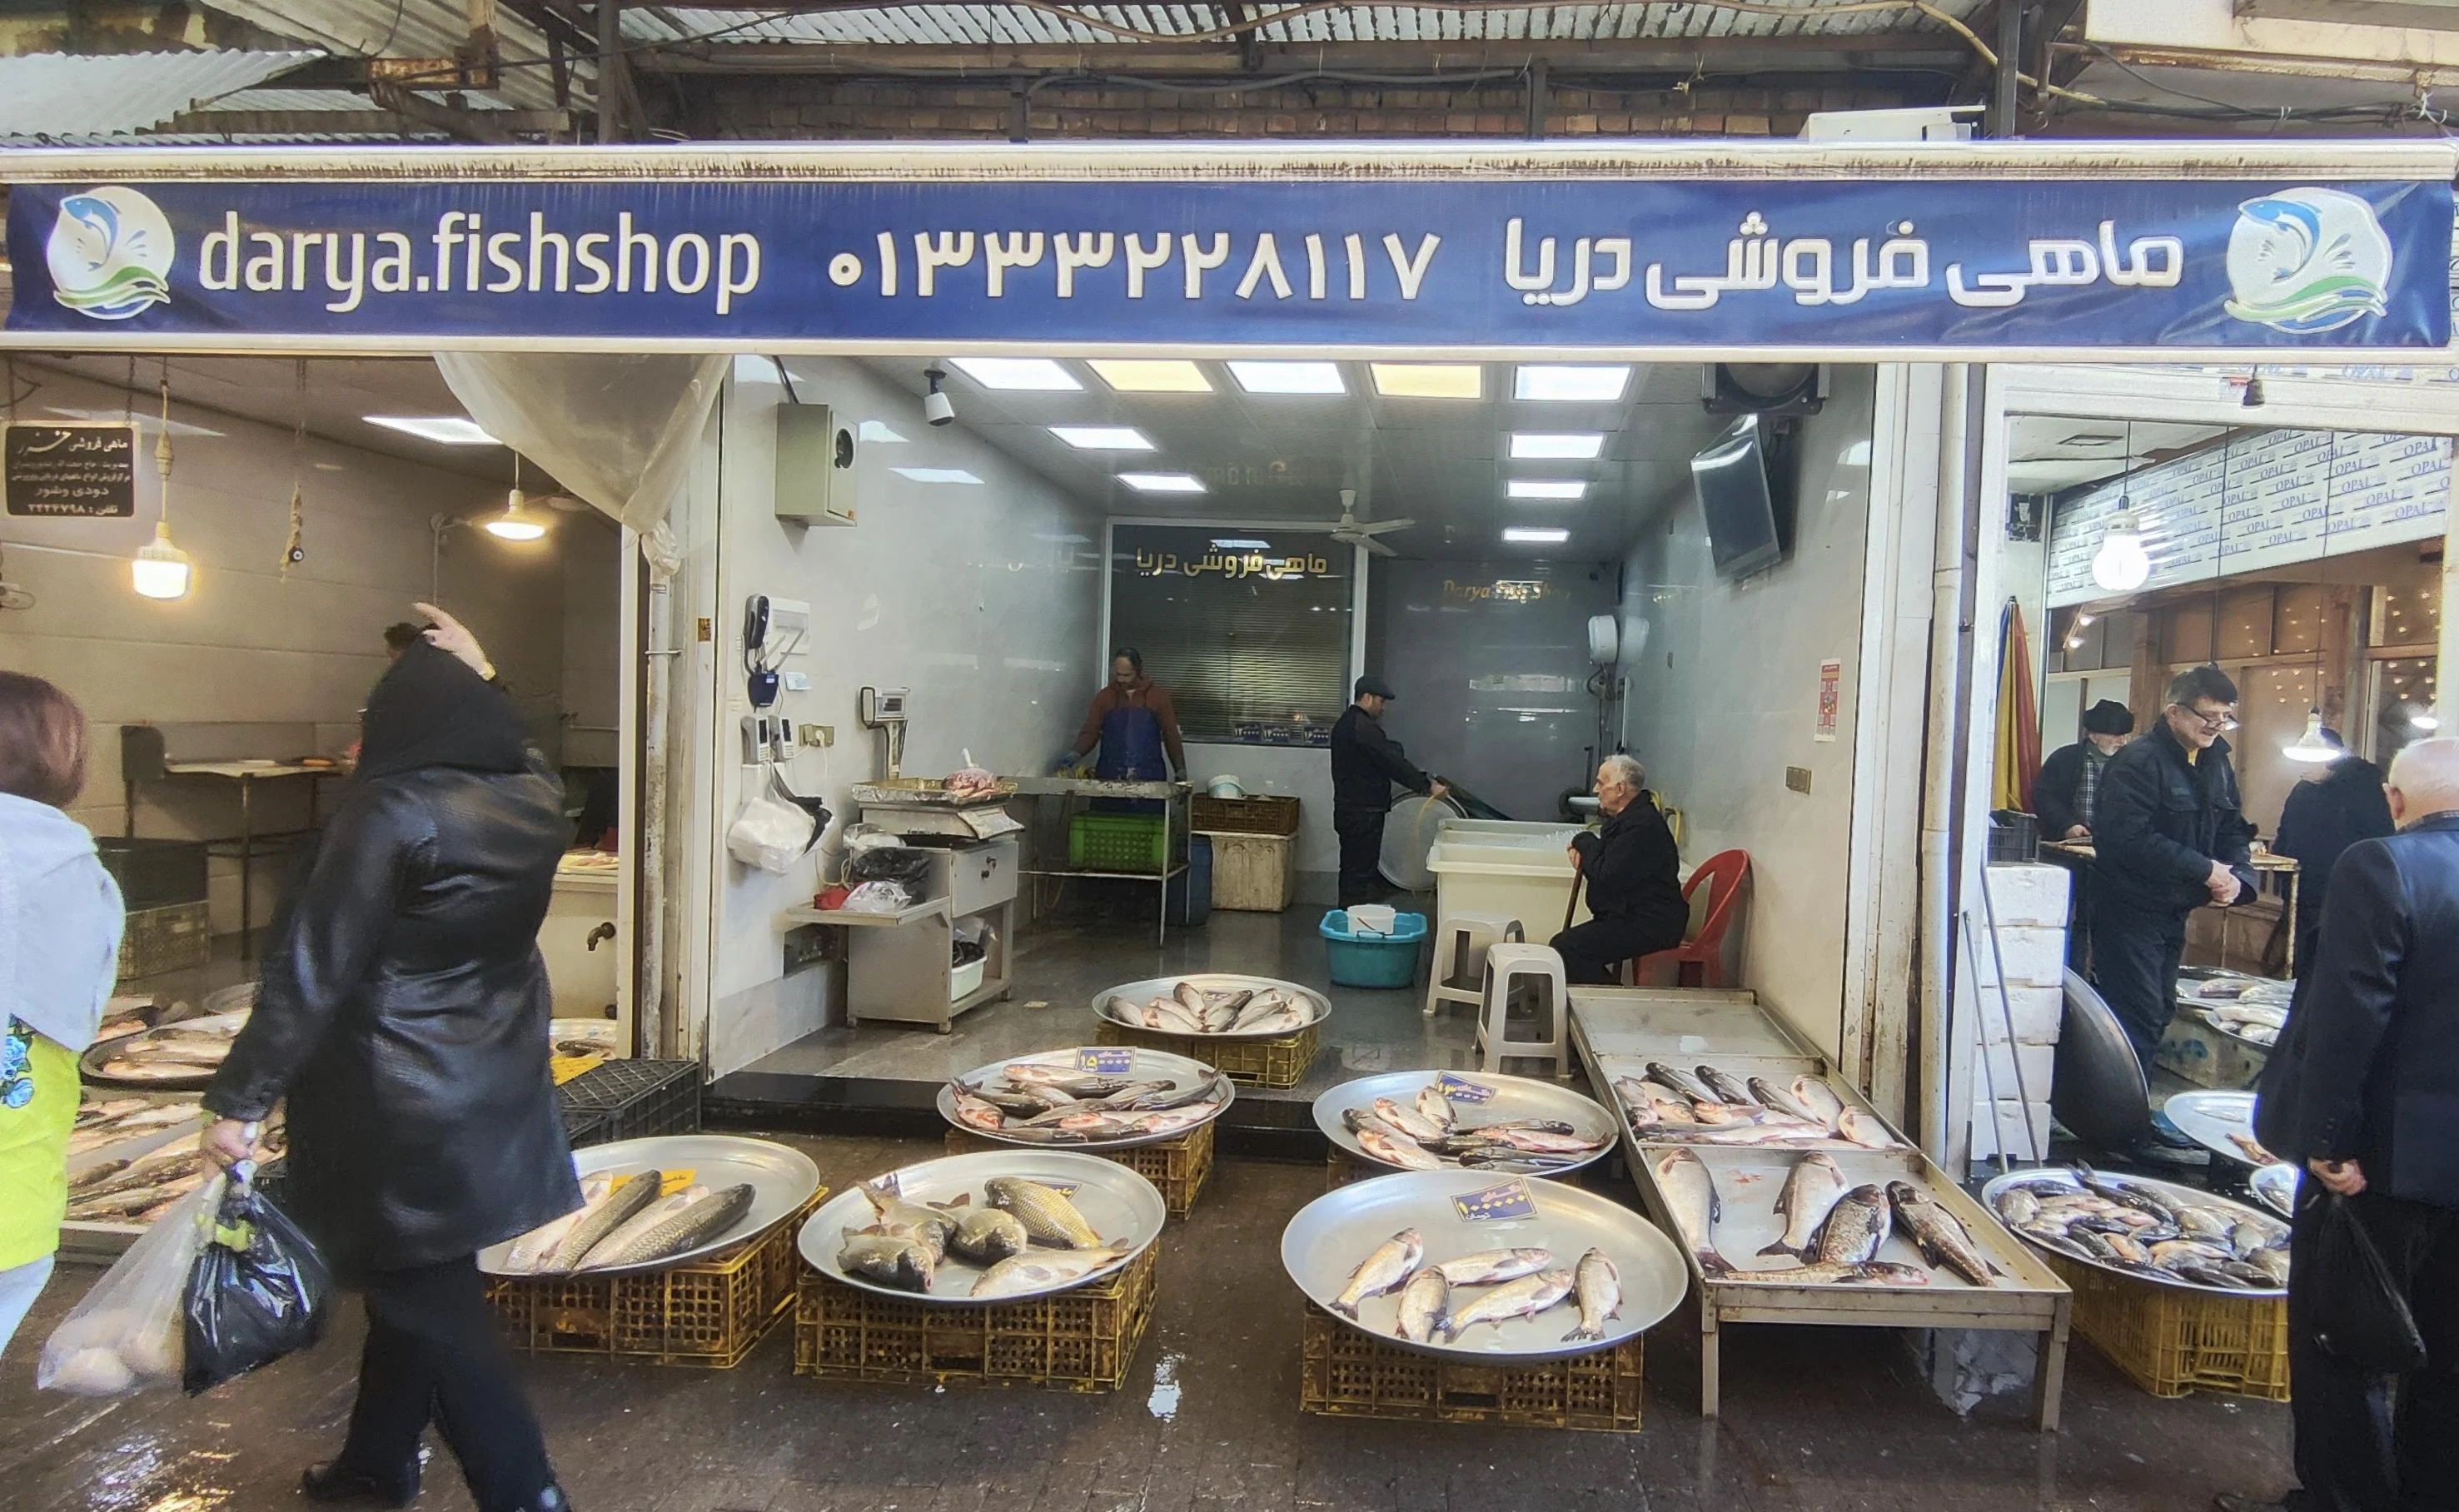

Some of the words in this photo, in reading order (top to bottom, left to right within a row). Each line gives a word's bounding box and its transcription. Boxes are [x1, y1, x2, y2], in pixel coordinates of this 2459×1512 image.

[199, 211, 761, 315] darya.fishshop
[828, 230, 1441, 300] ۰۱۳۳۳۲۲۸۱۱۷
[1506, 217, 1631, 306] دریا
[1645, 211, 1930, 310] فروشی
[1945, 220, 2183, 308] ماهی
[2294, 436, 2320, 452] OPAL
[2336, 458, 2362, 475] OPAL
[2412, 459, 2445, 475] OPAL
[2275, 475, 2300, 490] OPAL
[2342, 477, 2370, 492] OPAL
[2282, 493, 2306, 508] OPAL
[2367, 490, 2396, 505] OPAL
[2395, 502, 2427, 518] OPAL
[1137, 547, 1177, 576] دریا
[1183, 544, 1263, 579] فروشی
[1266, 553, 1327, 579] ماهی
